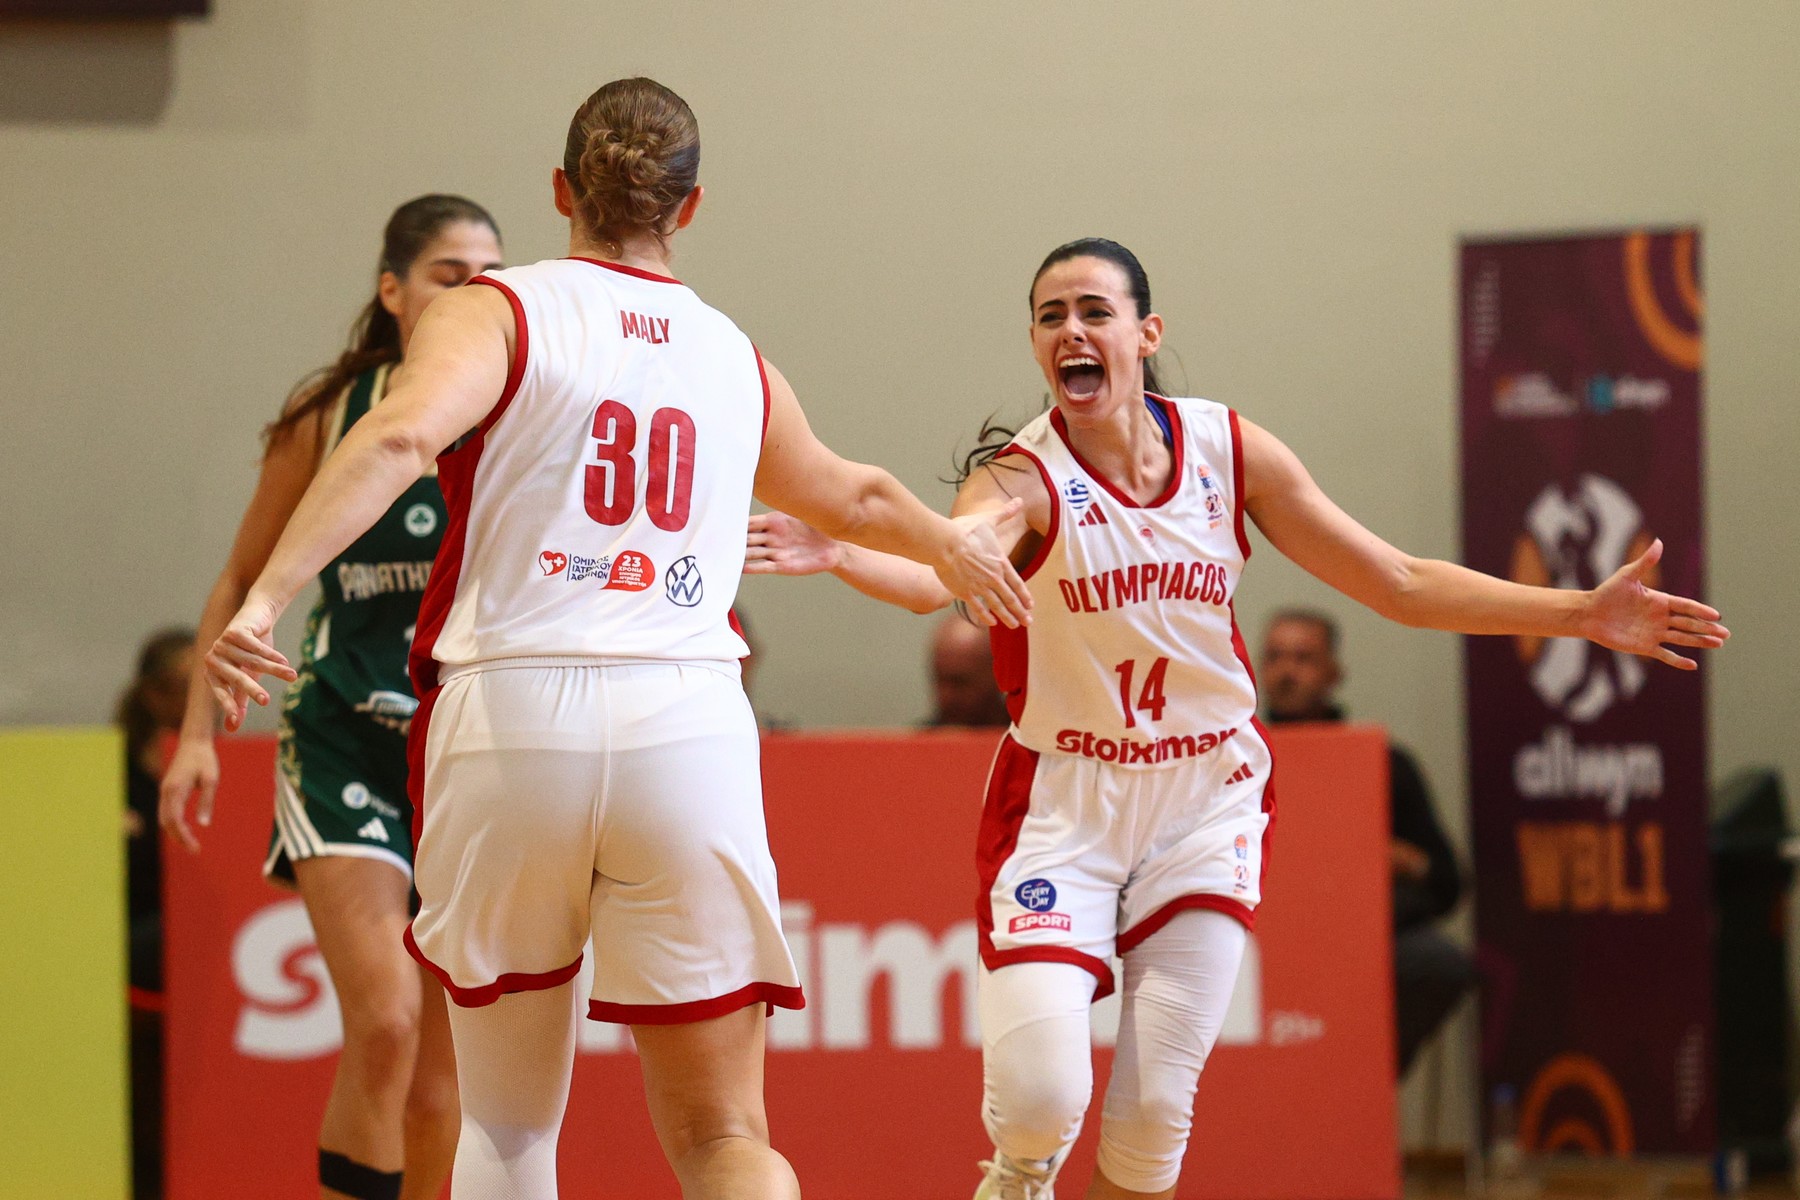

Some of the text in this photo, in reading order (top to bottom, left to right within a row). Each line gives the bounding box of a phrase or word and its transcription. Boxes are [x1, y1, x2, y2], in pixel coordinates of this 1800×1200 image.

[620, 310, 669, 344] MALY
[583, 399, 696, 532] 30
[621, 555, 642, 568] 23
[1058, 561, 1227, 613] OLYMPIACOS
[1115, 657, 1169, 729] 14
[1014, 914, 1070, 931] SPORT
